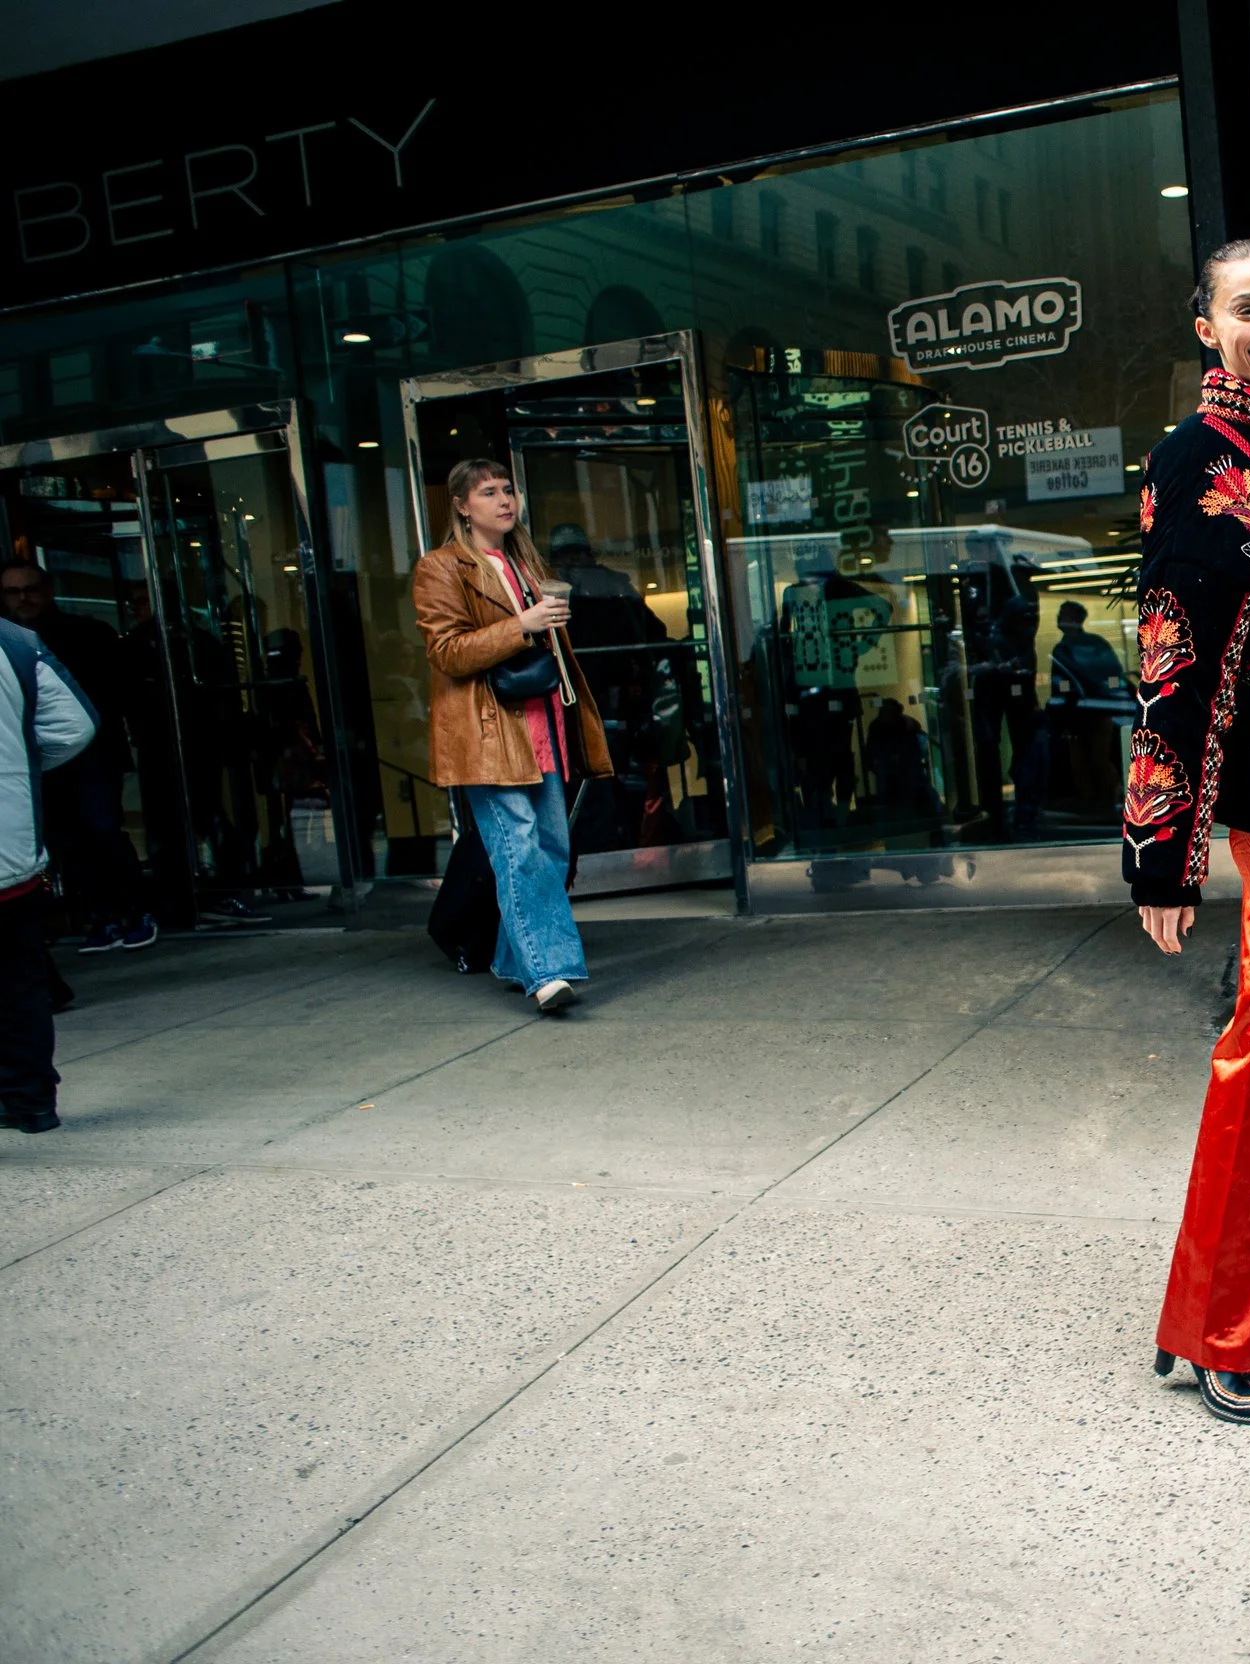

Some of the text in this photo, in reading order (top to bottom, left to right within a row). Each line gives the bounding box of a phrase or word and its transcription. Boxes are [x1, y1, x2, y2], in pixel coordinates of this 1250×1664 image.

[14, 98, 436, 263] BERTY
[906, 291, 1066, 345] ALAMO
[1005, 331, 1057, 347] CINEMA
[910, 416, 983, 448] Court
[996, 417, 1072, 440] TENNIS &
[998, 432, 1094, 458] PICKLEBALL
[956, 452, 983, 478] 16
